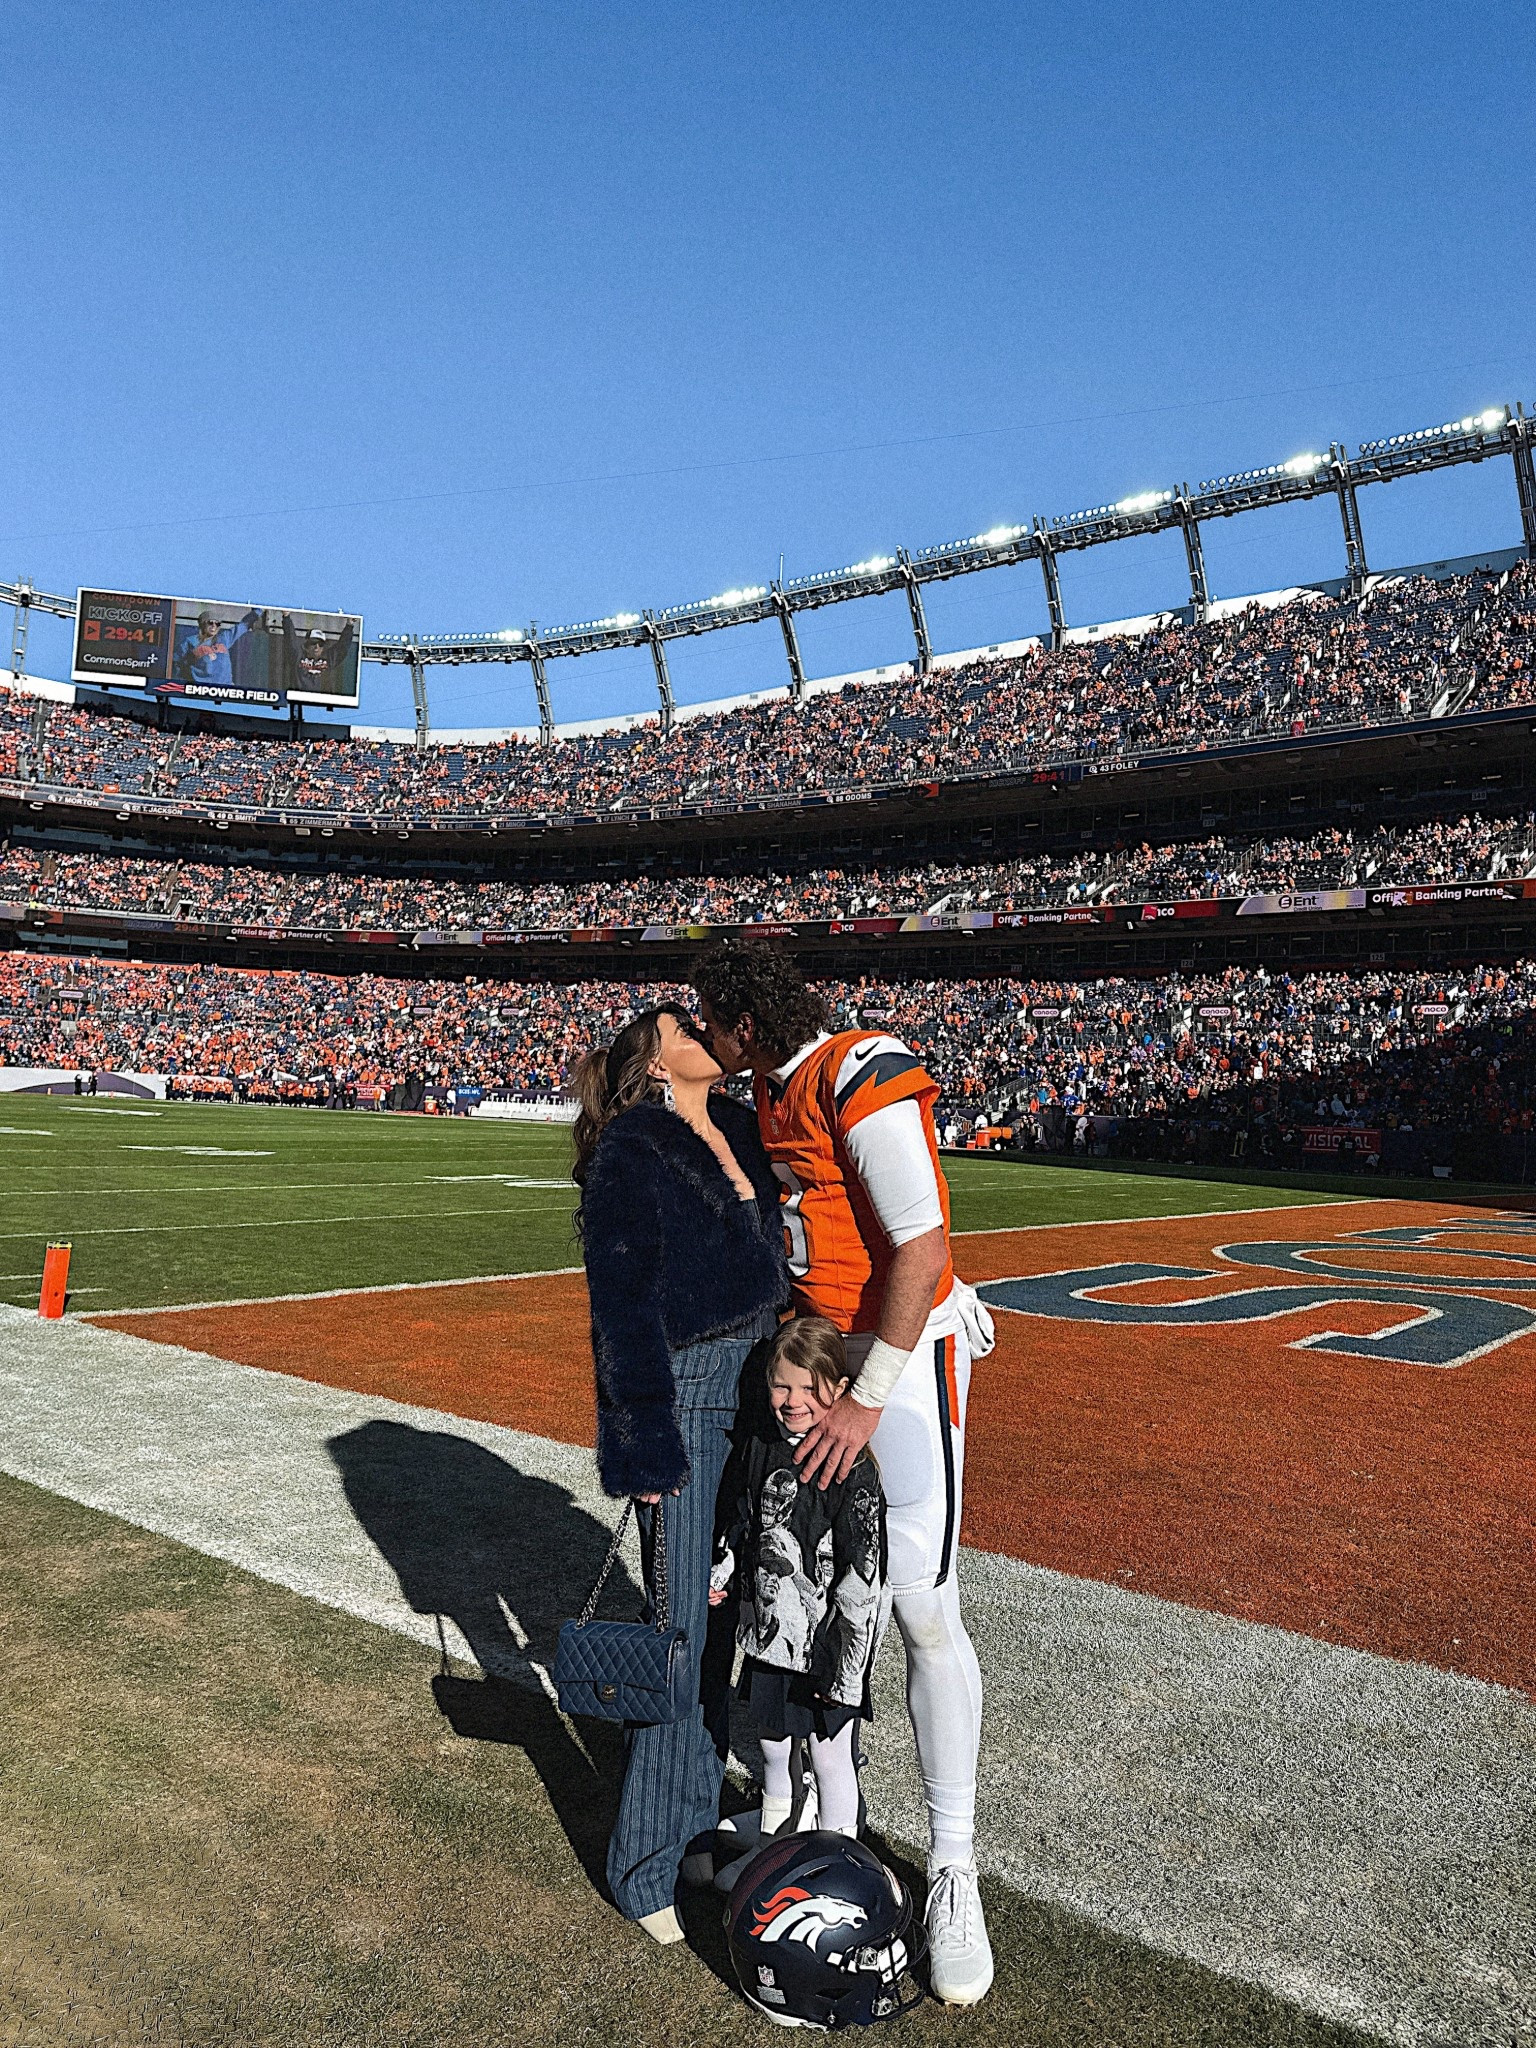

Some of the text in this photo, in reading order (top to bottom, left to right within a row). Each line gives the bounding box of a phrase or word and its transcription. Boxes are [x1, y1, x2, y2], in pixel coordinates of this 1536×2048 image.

[92, 593, 160, 606] COUNTDOWN
[88, 605, 163, 625] KICKOFF
[104, 626, 154, 643] 29:41
[83, 653, 151, 668] CommonSpirit
[185, 684, 279, 702] EMPOWER FIELD
[1099, 760, 1140, 772] 43 FOLEY
[1032, 770, 1065, 784] 29:41
[64, 797, 100, 807] MORTON
[845, 792, 872, 802] ODOMS
[766, 799, 802, 809] SHANAHAN
[148, 806, 183, 816] JACKSON
[711, 806, 735, 814] BAILEY
[234, 814, 257, 822] SMITH
[300, 819, 342, 827] ZIMMERMAN
[1372, 887, 1504, 903] Offi Banking Partne
[1293, 895, 1318, 907] Ent
[941, 916, 959, 925] Ent
[1028, 913, 1062, 923] Banking
[1063, 912, 1092, 921] Partne
[174, 923, 206, 933] 29:41
[674, 928, 688, 936] Ent
[770, 926, 792, 934] Partne
[231, 928, 257, 936] Official
[287, 931, 314, 939] Partner
[314, 931, 323, 939] of
[485, 933, 507, 942] Official
[530, 933, 552, 941] Partner
[551, 932, 558, 940] of
